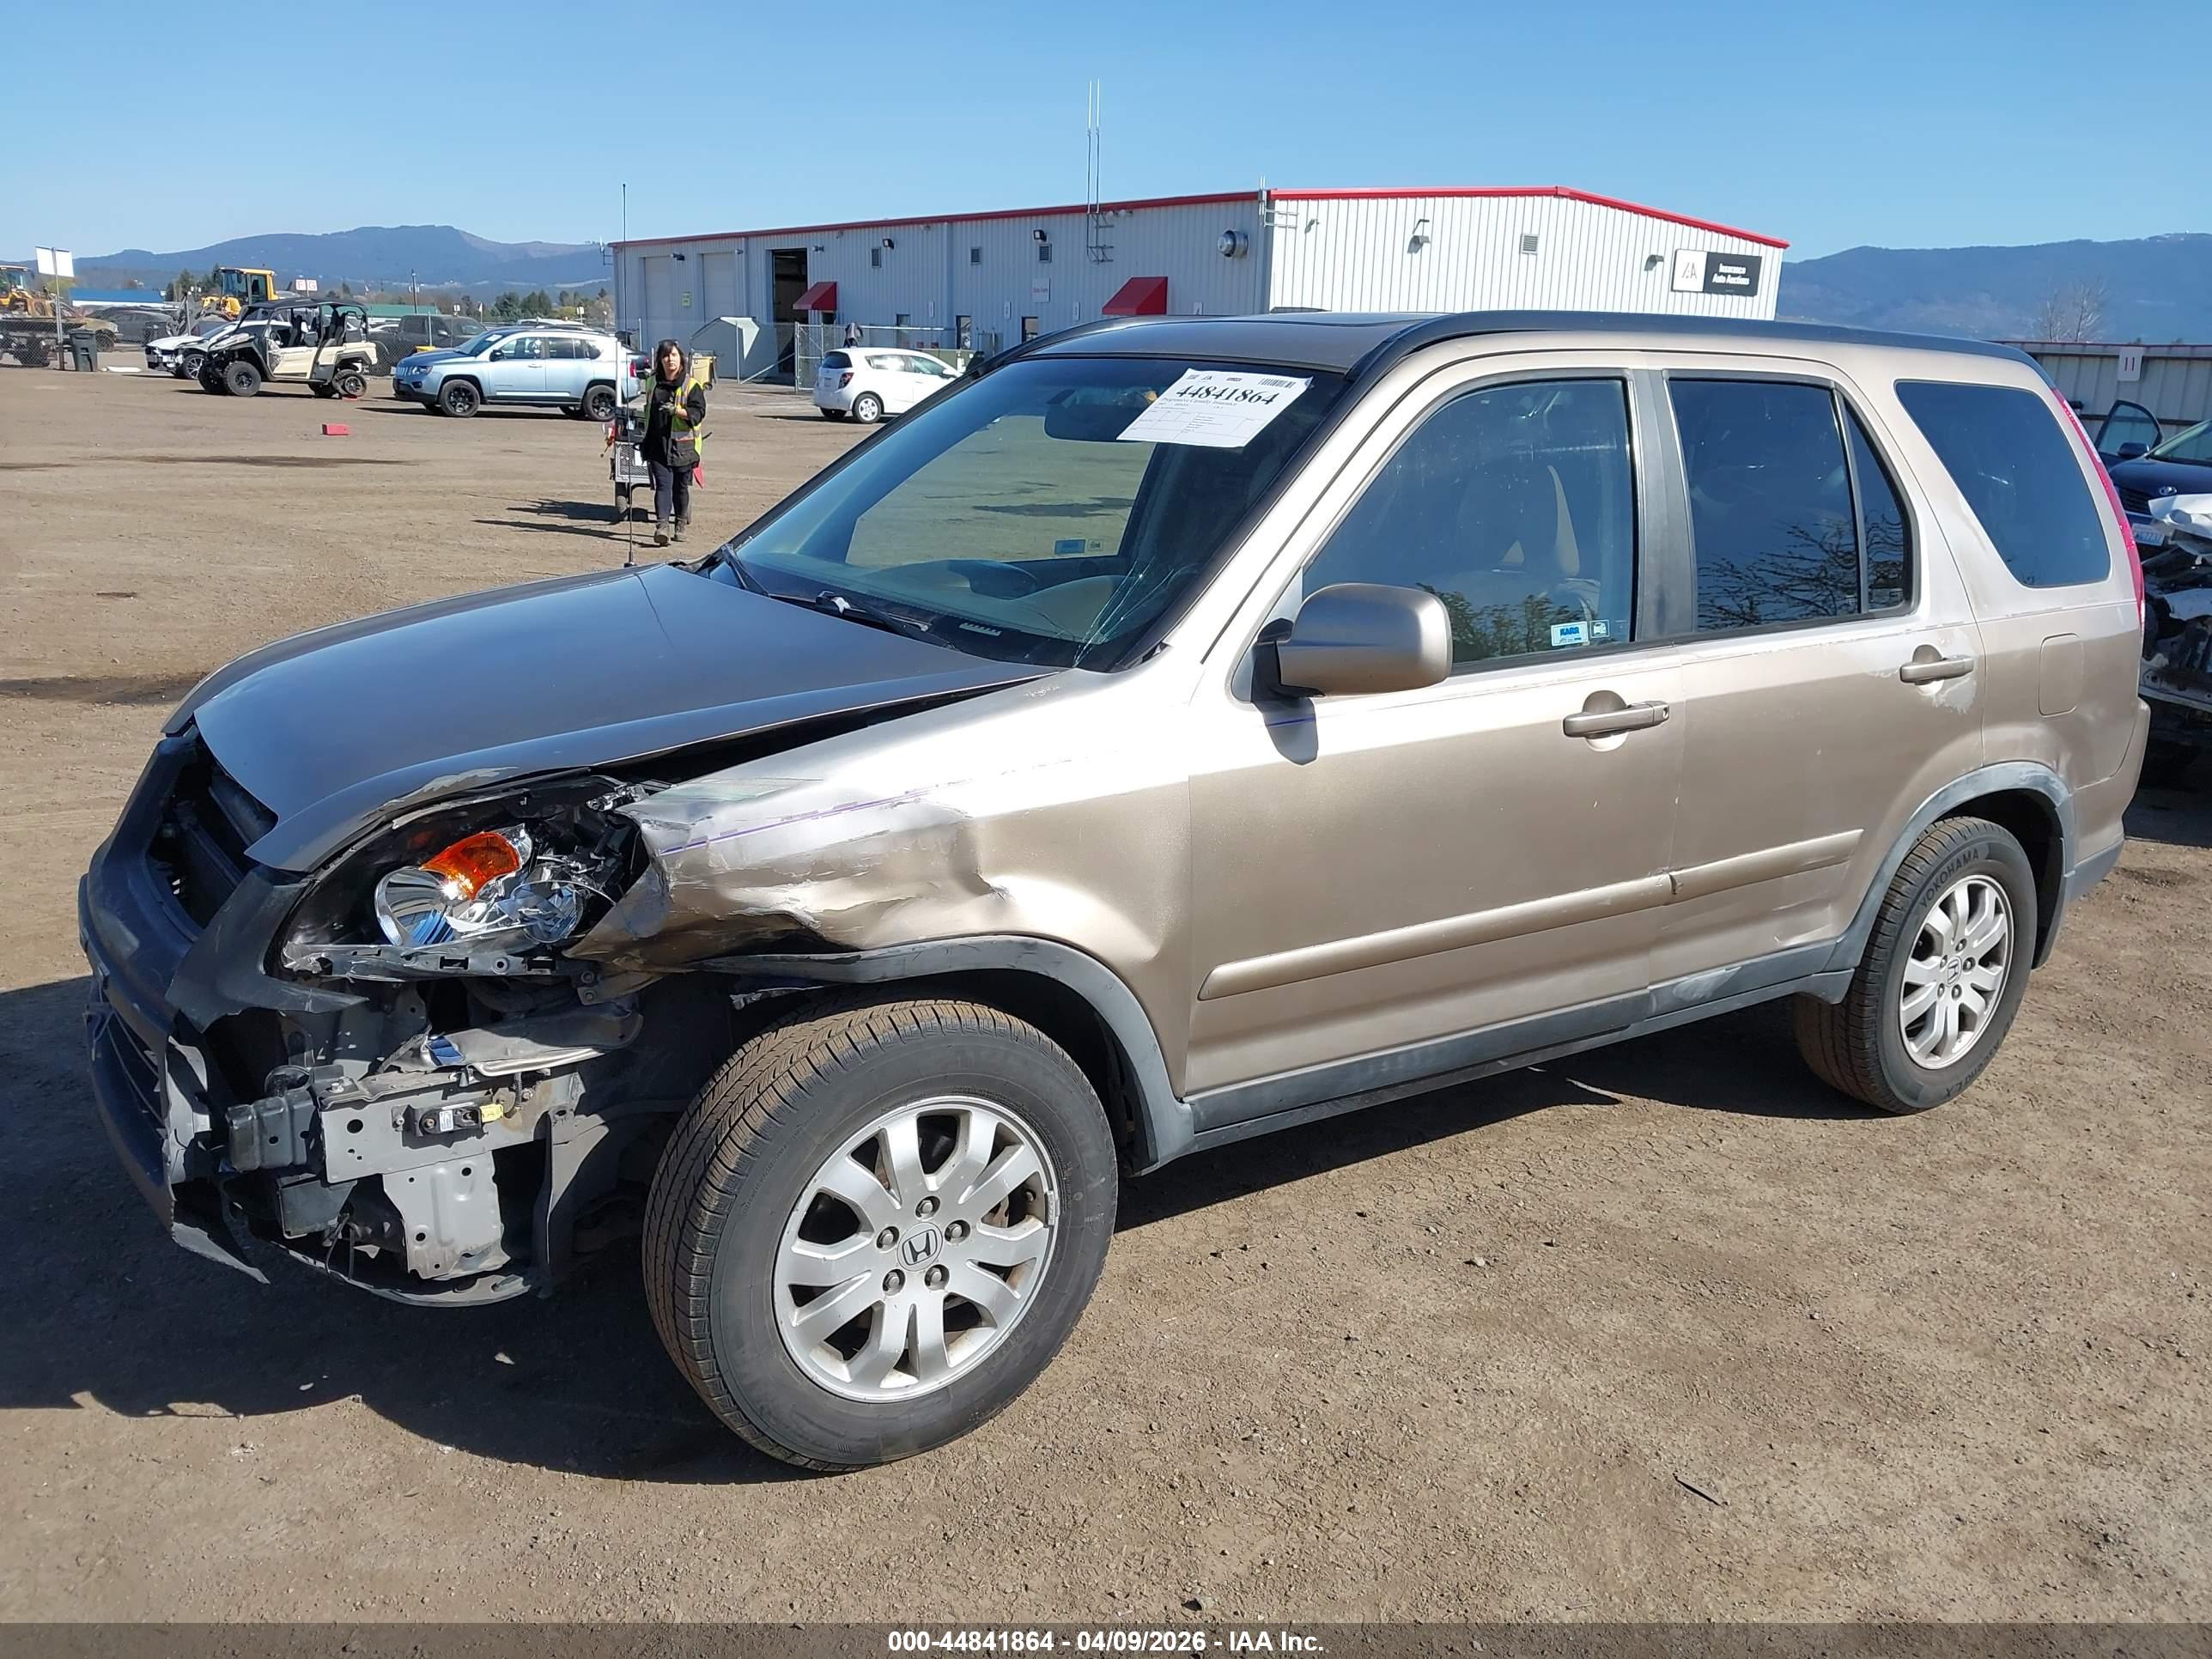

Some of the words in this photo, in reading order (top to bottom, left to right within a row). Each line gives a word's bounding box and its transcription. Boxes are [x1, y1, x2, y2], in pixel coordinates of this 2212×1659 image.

[1711, 273, 1726, 283] Auto
[1176, 385, 1279, 405] 44841864
[1919, 848, 1978, 908] YOKOHAMA
